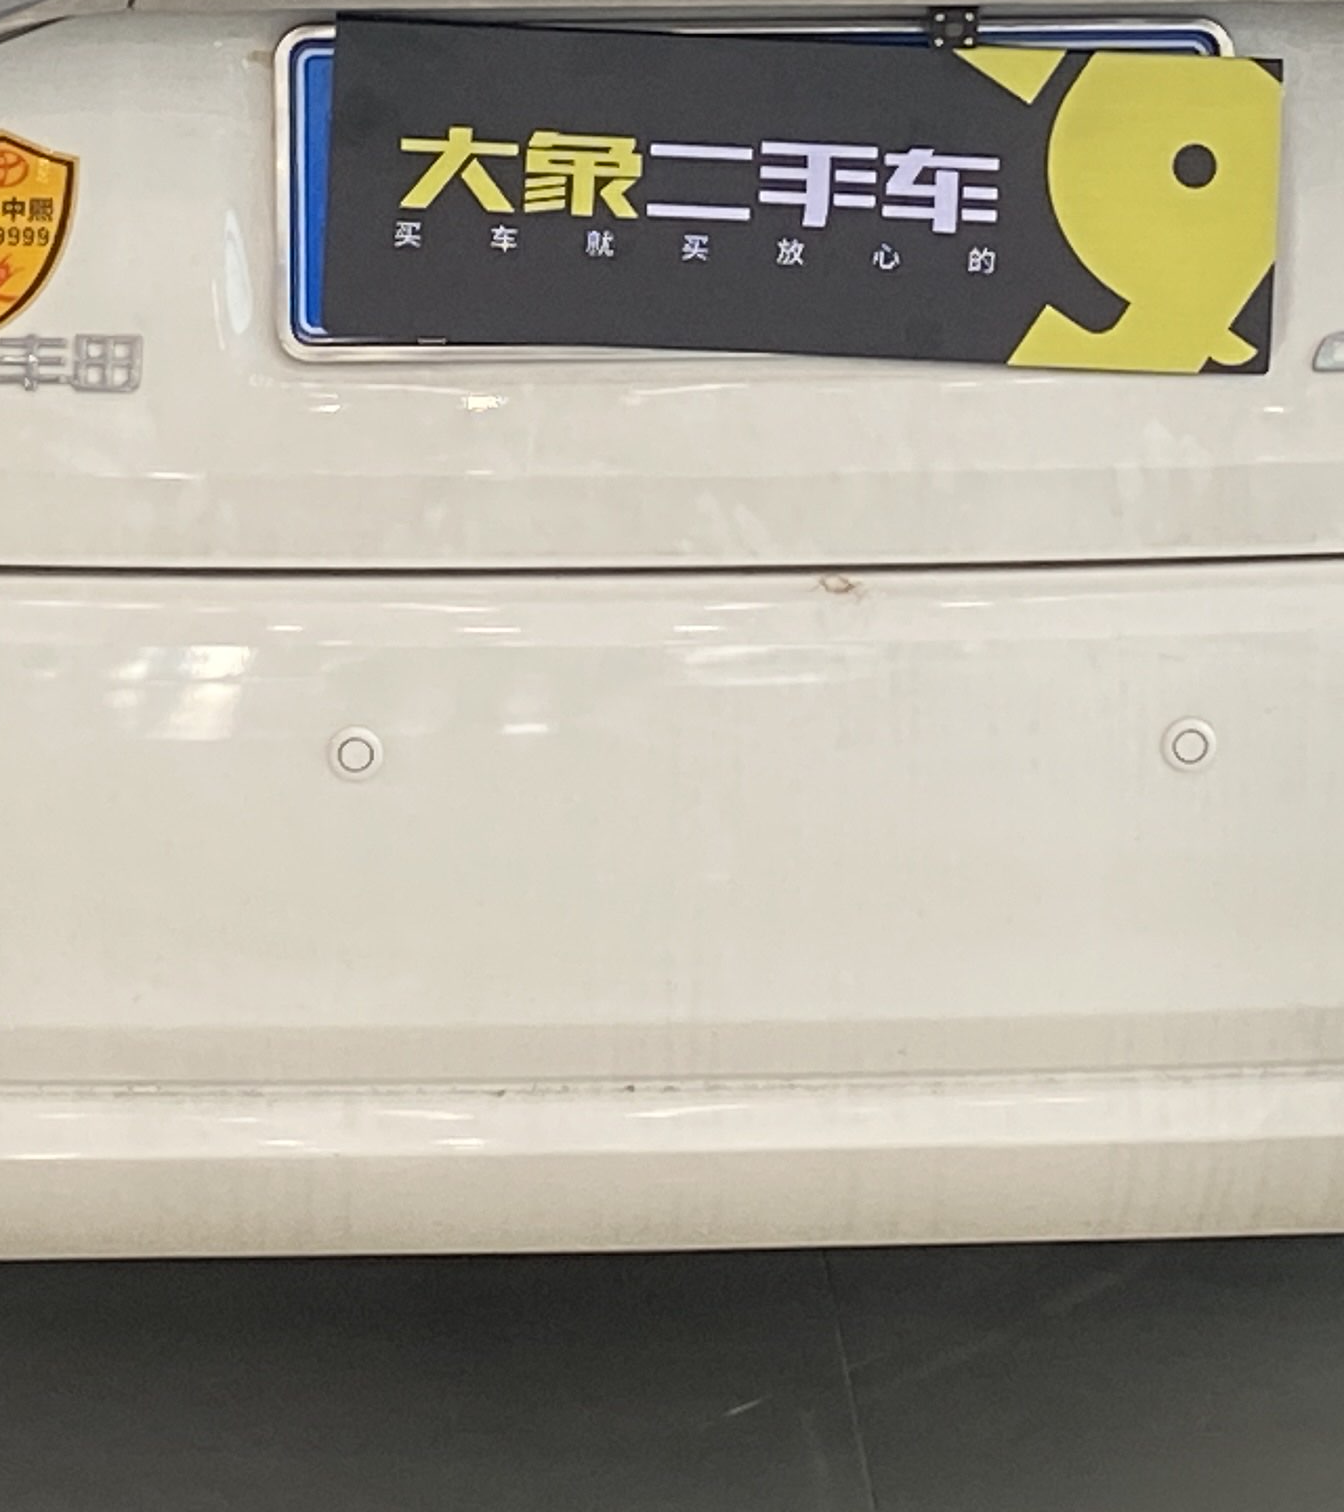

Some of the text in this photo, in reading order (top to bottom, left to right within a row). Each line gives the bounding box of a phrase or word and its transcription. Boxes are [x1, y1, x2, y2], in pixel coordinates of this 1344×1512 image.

[399, 126, 1000, 234] 大象二手车
